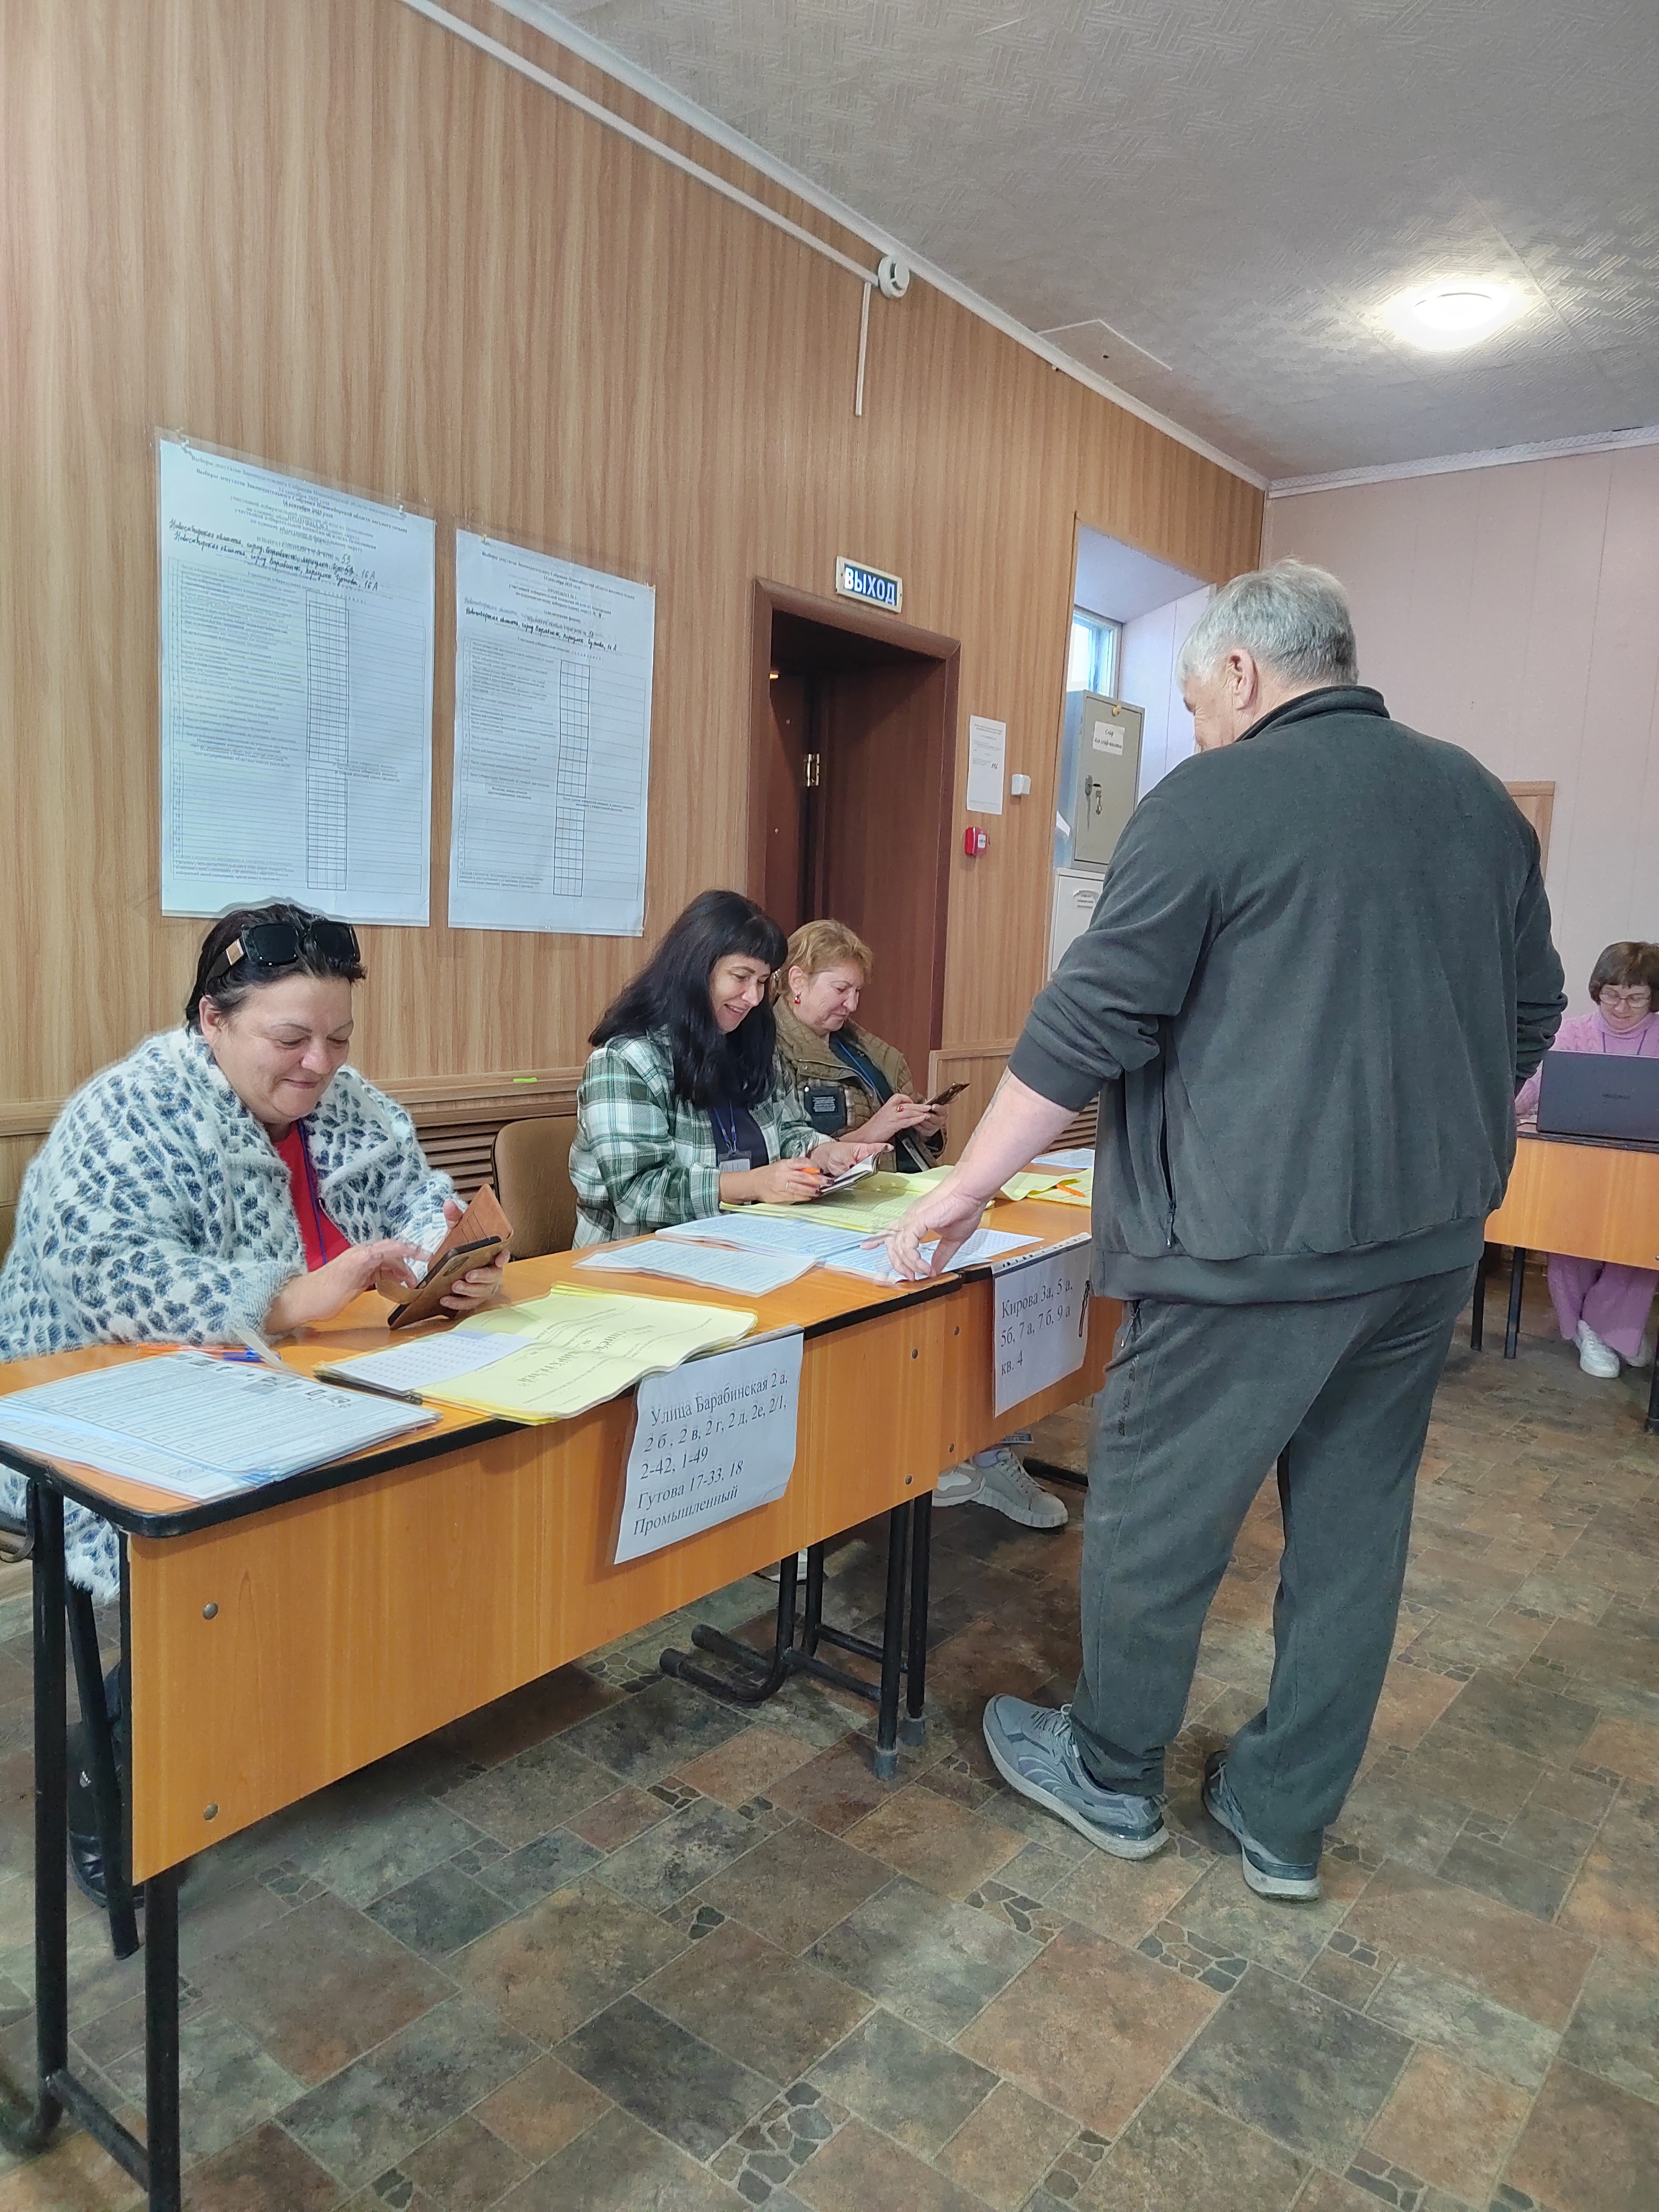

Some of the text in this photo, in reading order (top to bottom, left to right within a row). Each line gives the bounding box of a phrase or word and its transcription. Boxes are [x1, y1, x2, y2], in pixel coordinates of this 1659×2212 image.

[844, 567, 895, 606] ВЫХОД
[1002, 1294, 1038, 1319] Кирова
[1001, 1350, 1023, 1376] кв. 4
[652, 1372, 788, 1426] Улица Барабинская 2 а,
[644, 1437, 653, 1453] 2
[678, 1429, 687, 1444] 2
[706, 1420, 713, 1436] 2
[728, 1413, 735, 1428] 2
[769, 1398, 786, 1414] 2/1,
[637, 1460, 744, 1511] Гутова 17-33, 18
[641, 1447, 708, 1480] 2-42, 1-49
[633, 1486, 738, 1536] Промышленный
